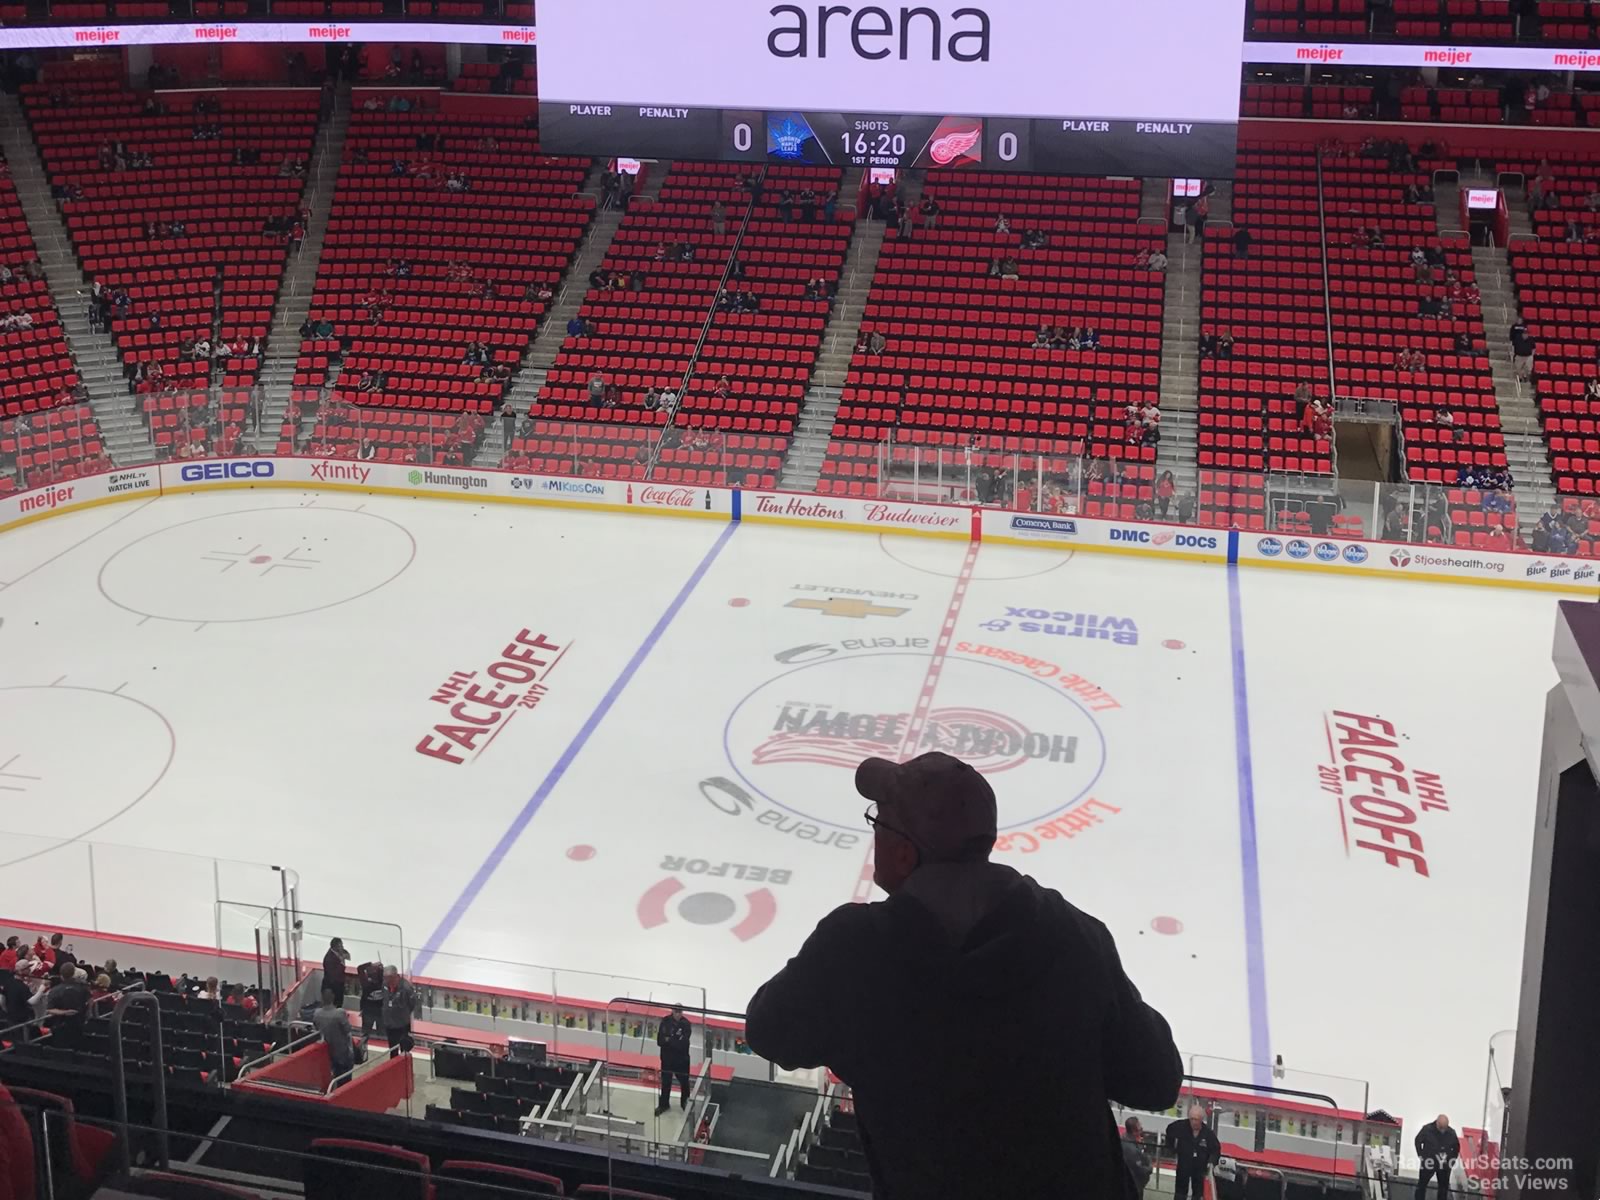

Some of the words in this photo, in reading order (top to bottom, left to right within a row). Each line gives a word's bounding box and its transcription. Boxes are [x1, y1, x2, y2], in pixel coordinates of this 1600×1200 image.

[75, 27, 121, 43] meijer
[195, 25, 238, 40] meijer
[309, 24, 351, 39] meijer
[502, 27, 536, 43] meije
[767, 4, 991, 62] arena
[1296, 44, 1344, 62] meijer
[1424, 48, 1472, 65] meijer
[570, 104, 612, 116] PLAYER
[639, 107, 689, 119] PENALTY
[855, 120, 889, 131] SHOTS
[1062, 120, 1110, 132] PLAYER
[1136, 123, 1193, 134] PENALTY
[734, 123, 752, 151] 0
[841, 132, 906, 156] 16:20
[998, 132, 1018, 161] 0
[851, 156, 866, 164] 1ST
[869, 156, 899, 165] PERIOD
[1470, 194, 1494, 204] meijer
[181, 461, 274, 482] GEICO
[310, 460, 371, 484] xfinity
[424, 471, 488, 489] Huntington
[108, 483, 133, 493] WATCH
[134, 479, 150, 489] LIVE
[19, 486, 75, 513] meijer
[756, 496, 784, 513] Tim
[786, 498, 845, 520] Hortons
[863, 503, 960, 527] Budweiser
[1052, 521, 1072, 530] Bank
[1109, 528, 1150, 543] DMC
[1175, 534, 1217, 549] DOCS
[1259, 539, 1282, 549] Kroger
[1287, 541, 1310, 552] Kroger
[1316, 544, 1339, 555] Kroger
[1344, 546, 1367, 557] Kroger
[1414, 554, 1504, 572] Stjoeshealth.org
[1526, 566, 1547, 576] Blue
[1550, 568, 1571, 578] Blue
[1574, 570, 1594, 580] Blue
[789, 583, 919, 600] CHEVROLET
[978, 618, 1012, 632] &
[1004, 606, 1138, 632] Wilcox
[1018, 621, 1138, 646] Burns
[840, 637, 930, 650] arena
[955, 640, 1061, 678] Caesars
[429, 670, 478, 705] NHL
[517, 683, 549, 709] 2017
[1059, 673, 1122, 712] Little
[1317, 764, 1344, 796] 2017
[1412, 769, 1450, 812] NHL
[1034, 797, 1122, 840] Little
[755, 808, 859, 850] arena
[659, 854, 792, 885] BELFOR
